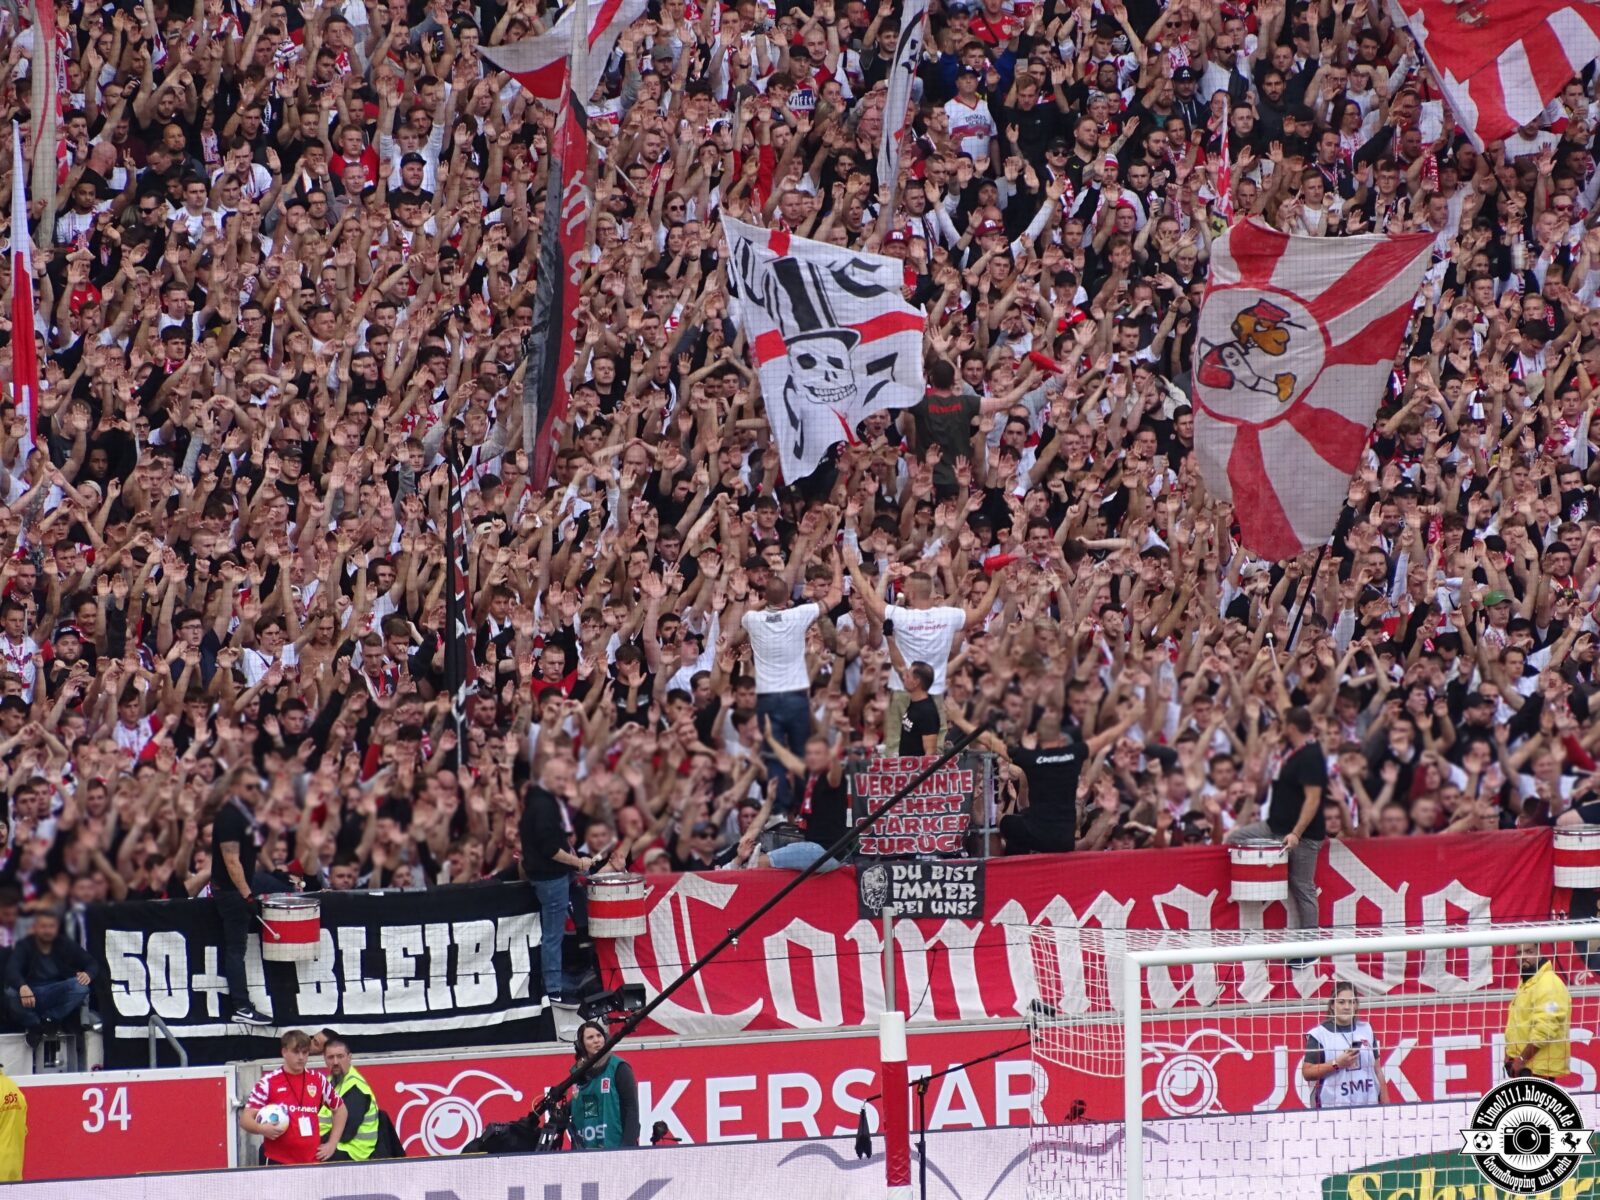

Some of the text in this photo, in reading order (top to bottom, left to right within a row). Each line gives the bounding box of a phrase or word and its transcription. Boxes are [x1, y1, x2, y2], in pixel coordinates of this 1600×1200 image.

[867, 794, 965, 816] KEHRT
[892, 865, 977, 882] DU BIST
[893, 882, 976, 900] IMMER
[893, 901, 977, 915] BEI UNS!
[296, 912, 543, 1016] BLEIBT
[1340, 1078, 1374, 1097] SMF
[82, 1086, 132, 1133] 34
